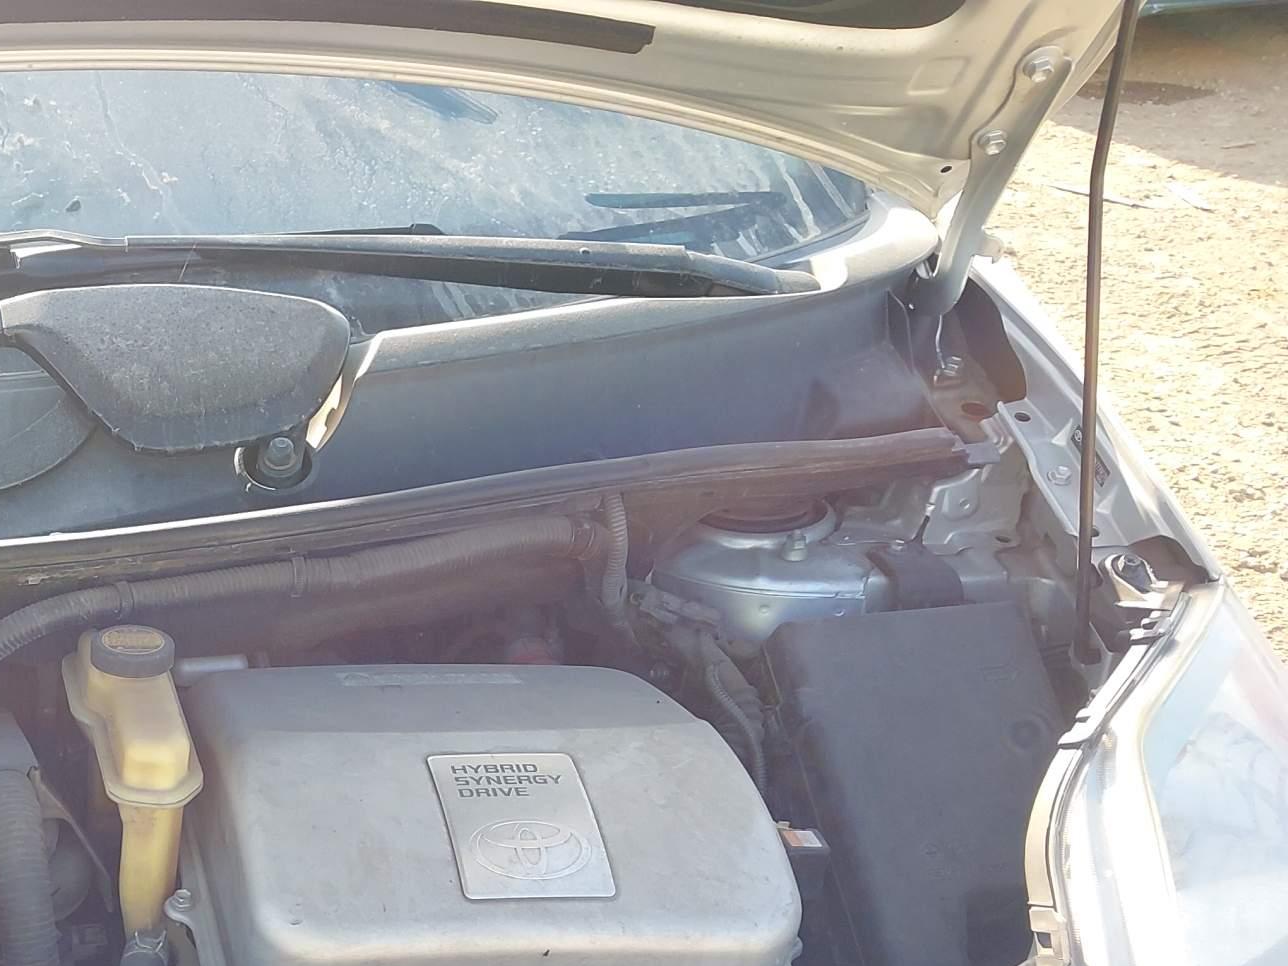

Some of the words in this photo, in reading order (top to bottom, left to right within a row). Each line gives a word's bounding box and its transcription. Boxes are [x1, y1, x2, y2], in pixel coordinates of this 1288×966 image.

[451, 764, 537, 774] HYBRID
[454, 774, 562, 785] SYNERGY
[459, 787, 530, 798] DRIVE
